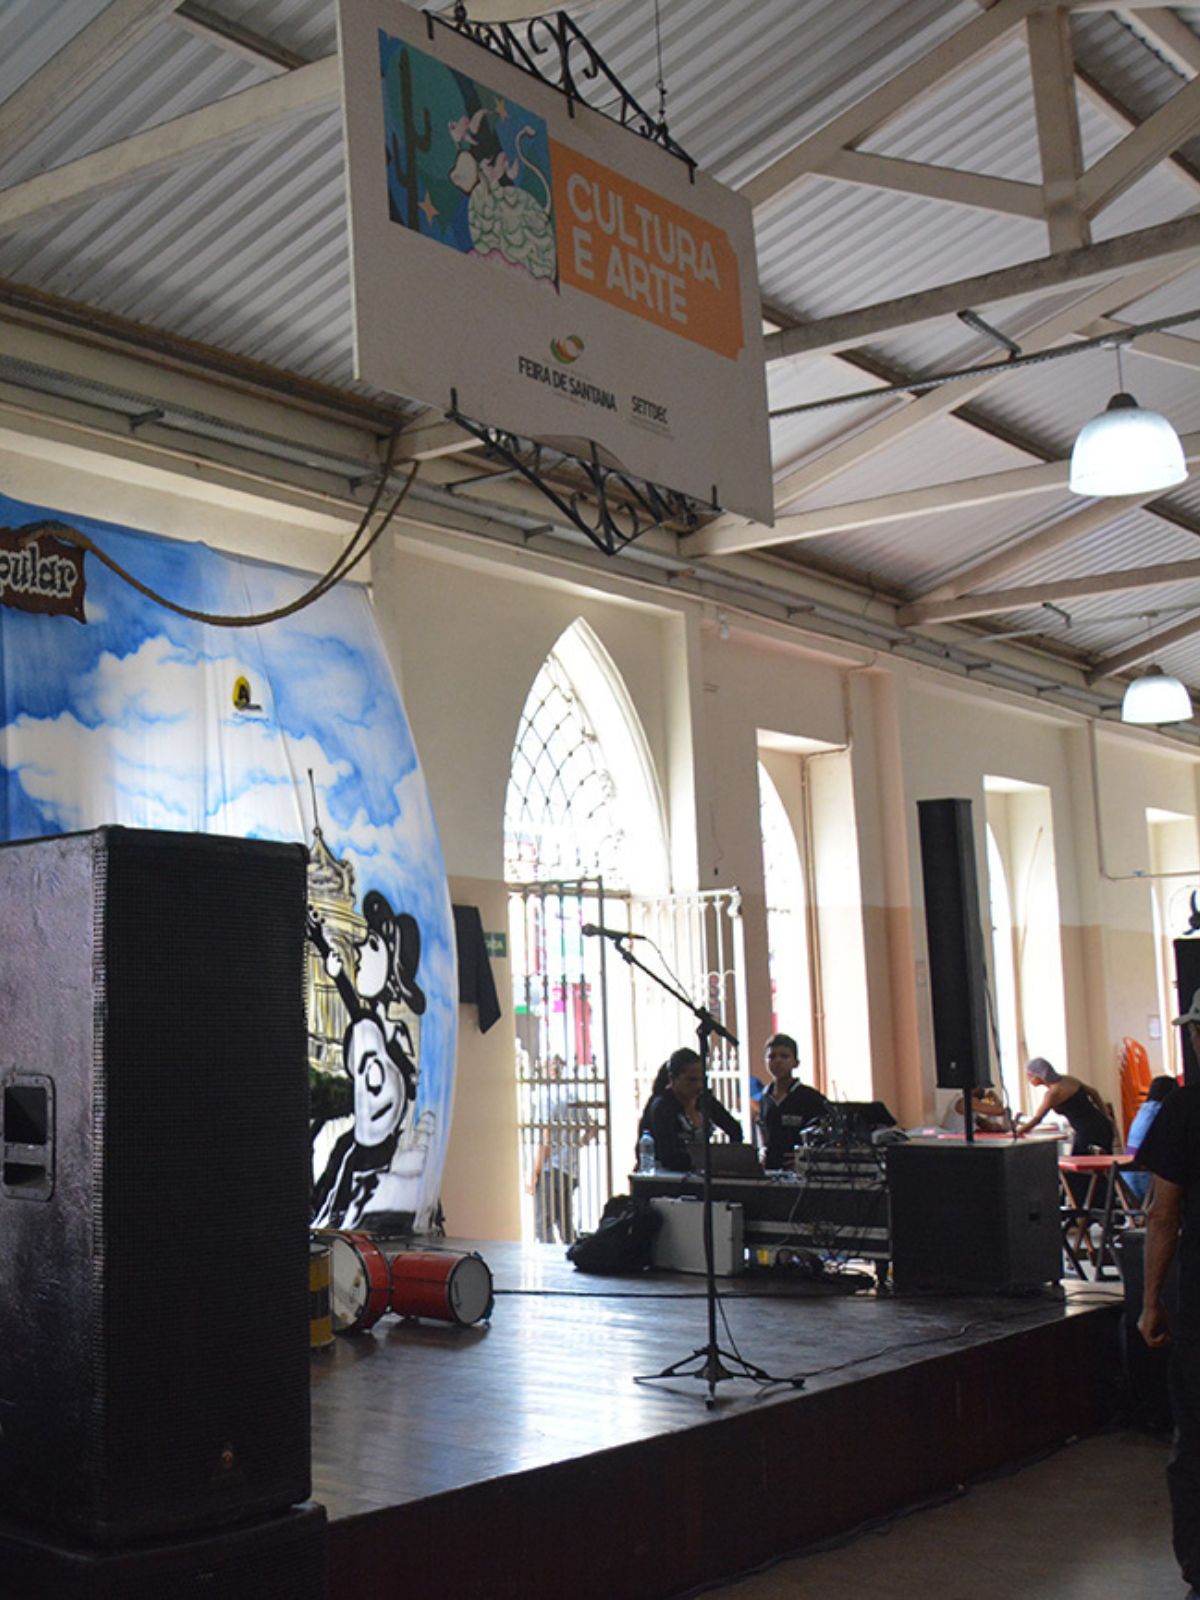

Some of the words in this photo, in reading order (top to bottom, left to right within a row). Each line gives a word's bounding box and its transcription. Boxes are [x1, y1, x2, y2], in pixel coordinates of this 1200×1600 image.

[566, 173, 721, 291] CULTURA
[572, 225, 595, 281] E
[606, 244, 688, 325] ARTE
[518, 355, 552, 386] FEIRA
[551, 370, 569, 393] DE
[569, 377, 618, 412] SANTANA
